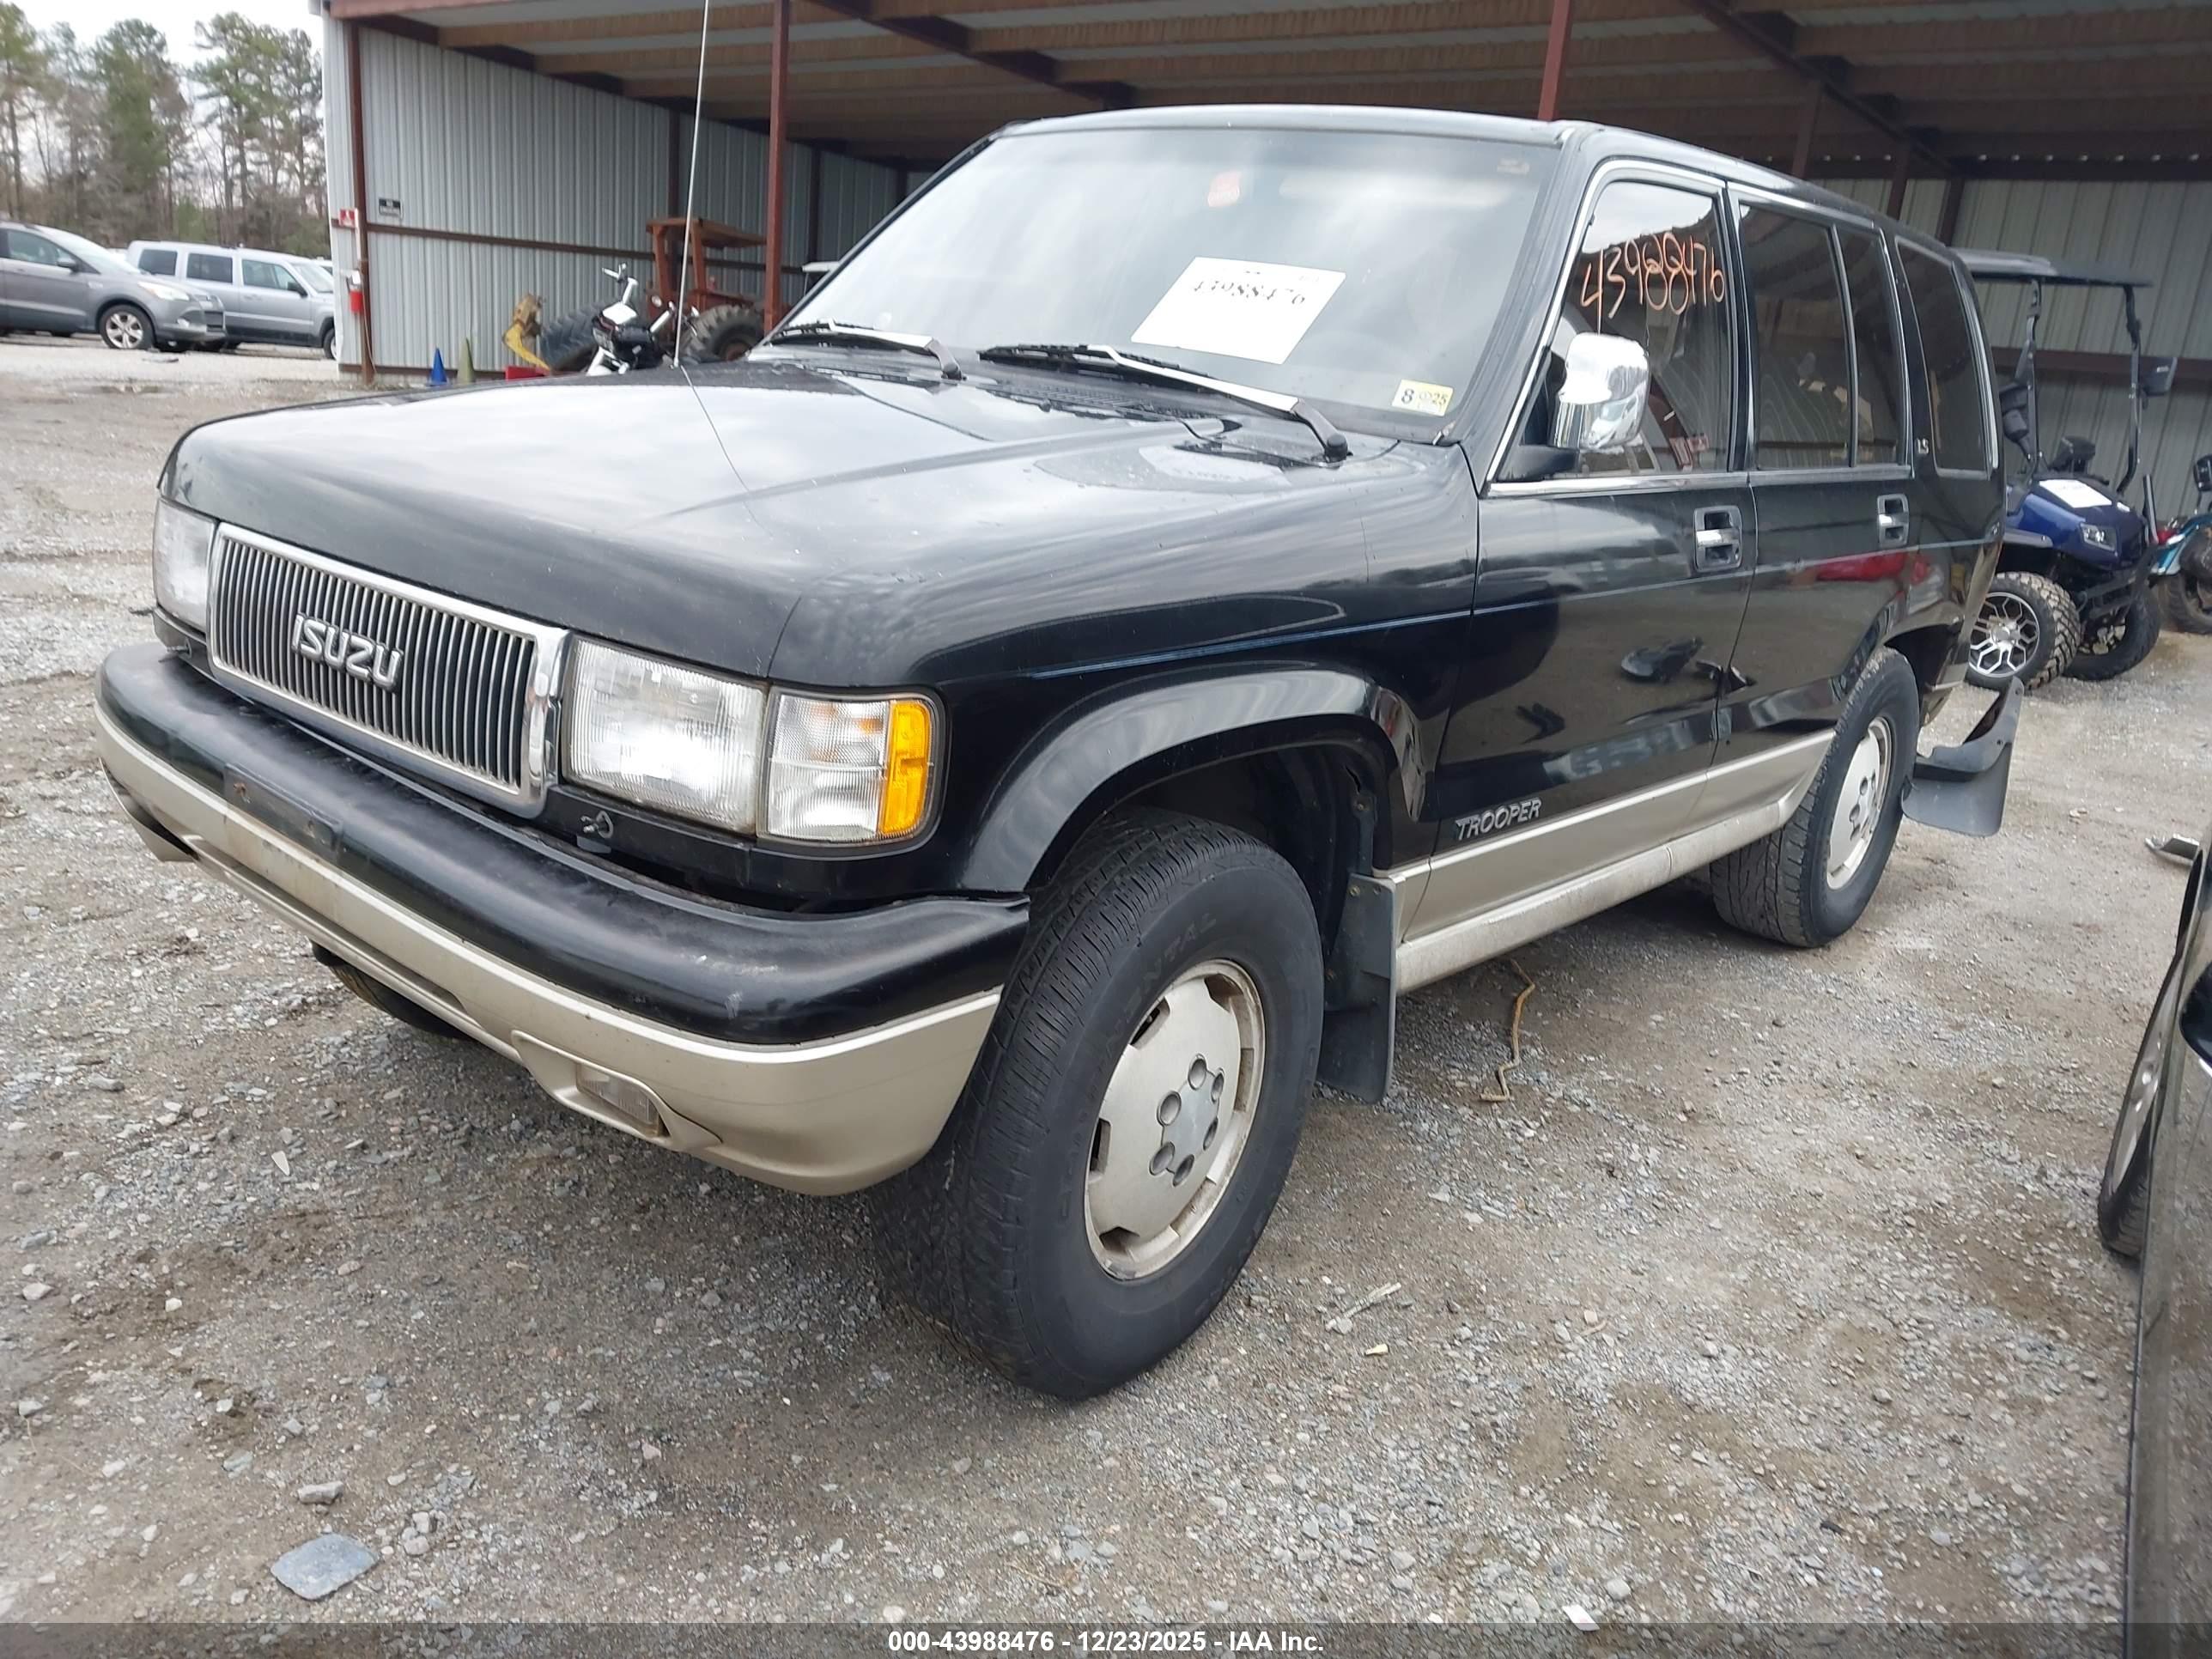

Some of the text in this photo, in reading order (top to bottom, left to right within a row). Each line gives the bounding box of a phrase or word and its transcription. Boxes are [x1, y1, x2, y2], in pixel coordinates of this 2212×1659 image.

[1581, 233, 1725, 323] 43988476
[1401, 389, 1415, 404] 8
[291, 612, 404, 690] ISUZU
[1455, 797, 1542, 841] TROOPER
